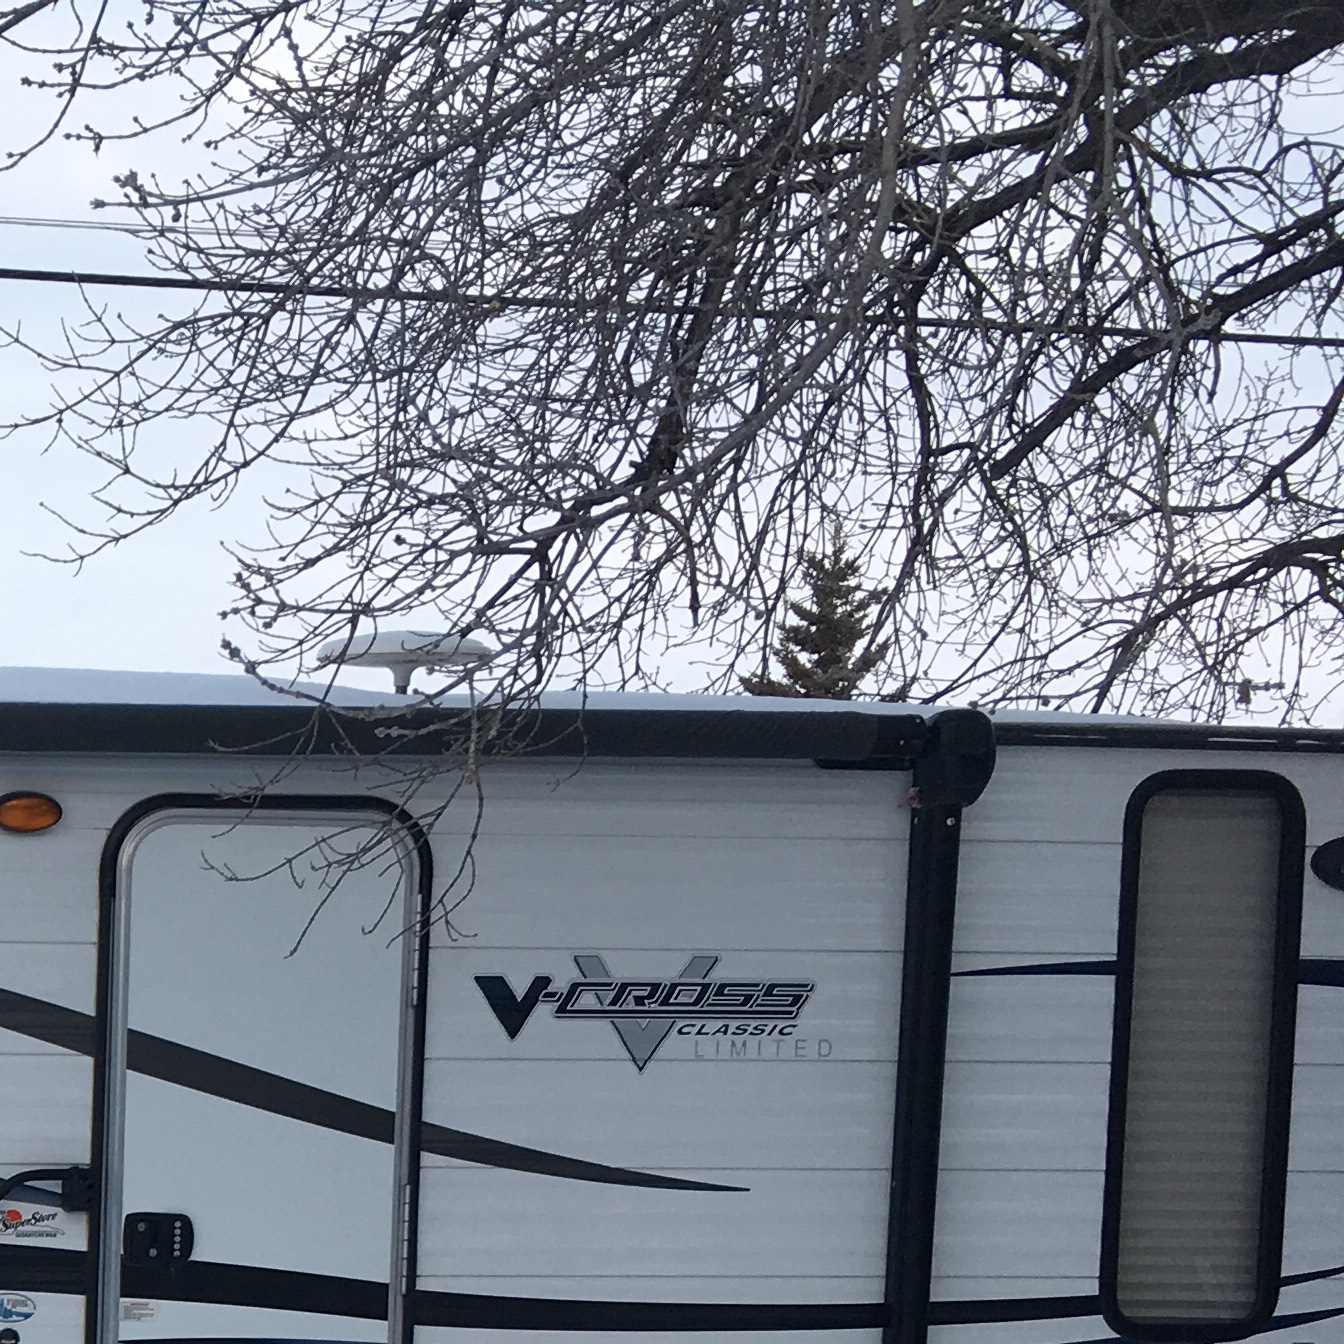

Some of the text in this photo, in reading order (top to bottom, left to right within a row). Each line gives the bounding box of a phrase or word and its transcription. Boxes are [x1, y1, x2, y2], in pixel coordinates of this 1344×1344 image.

[474, 974, 815, 1040] V-CROSS
[677, 1023, 798, 1036] CLASSIC
[694, 1039, 833, 1059] LIMITED
